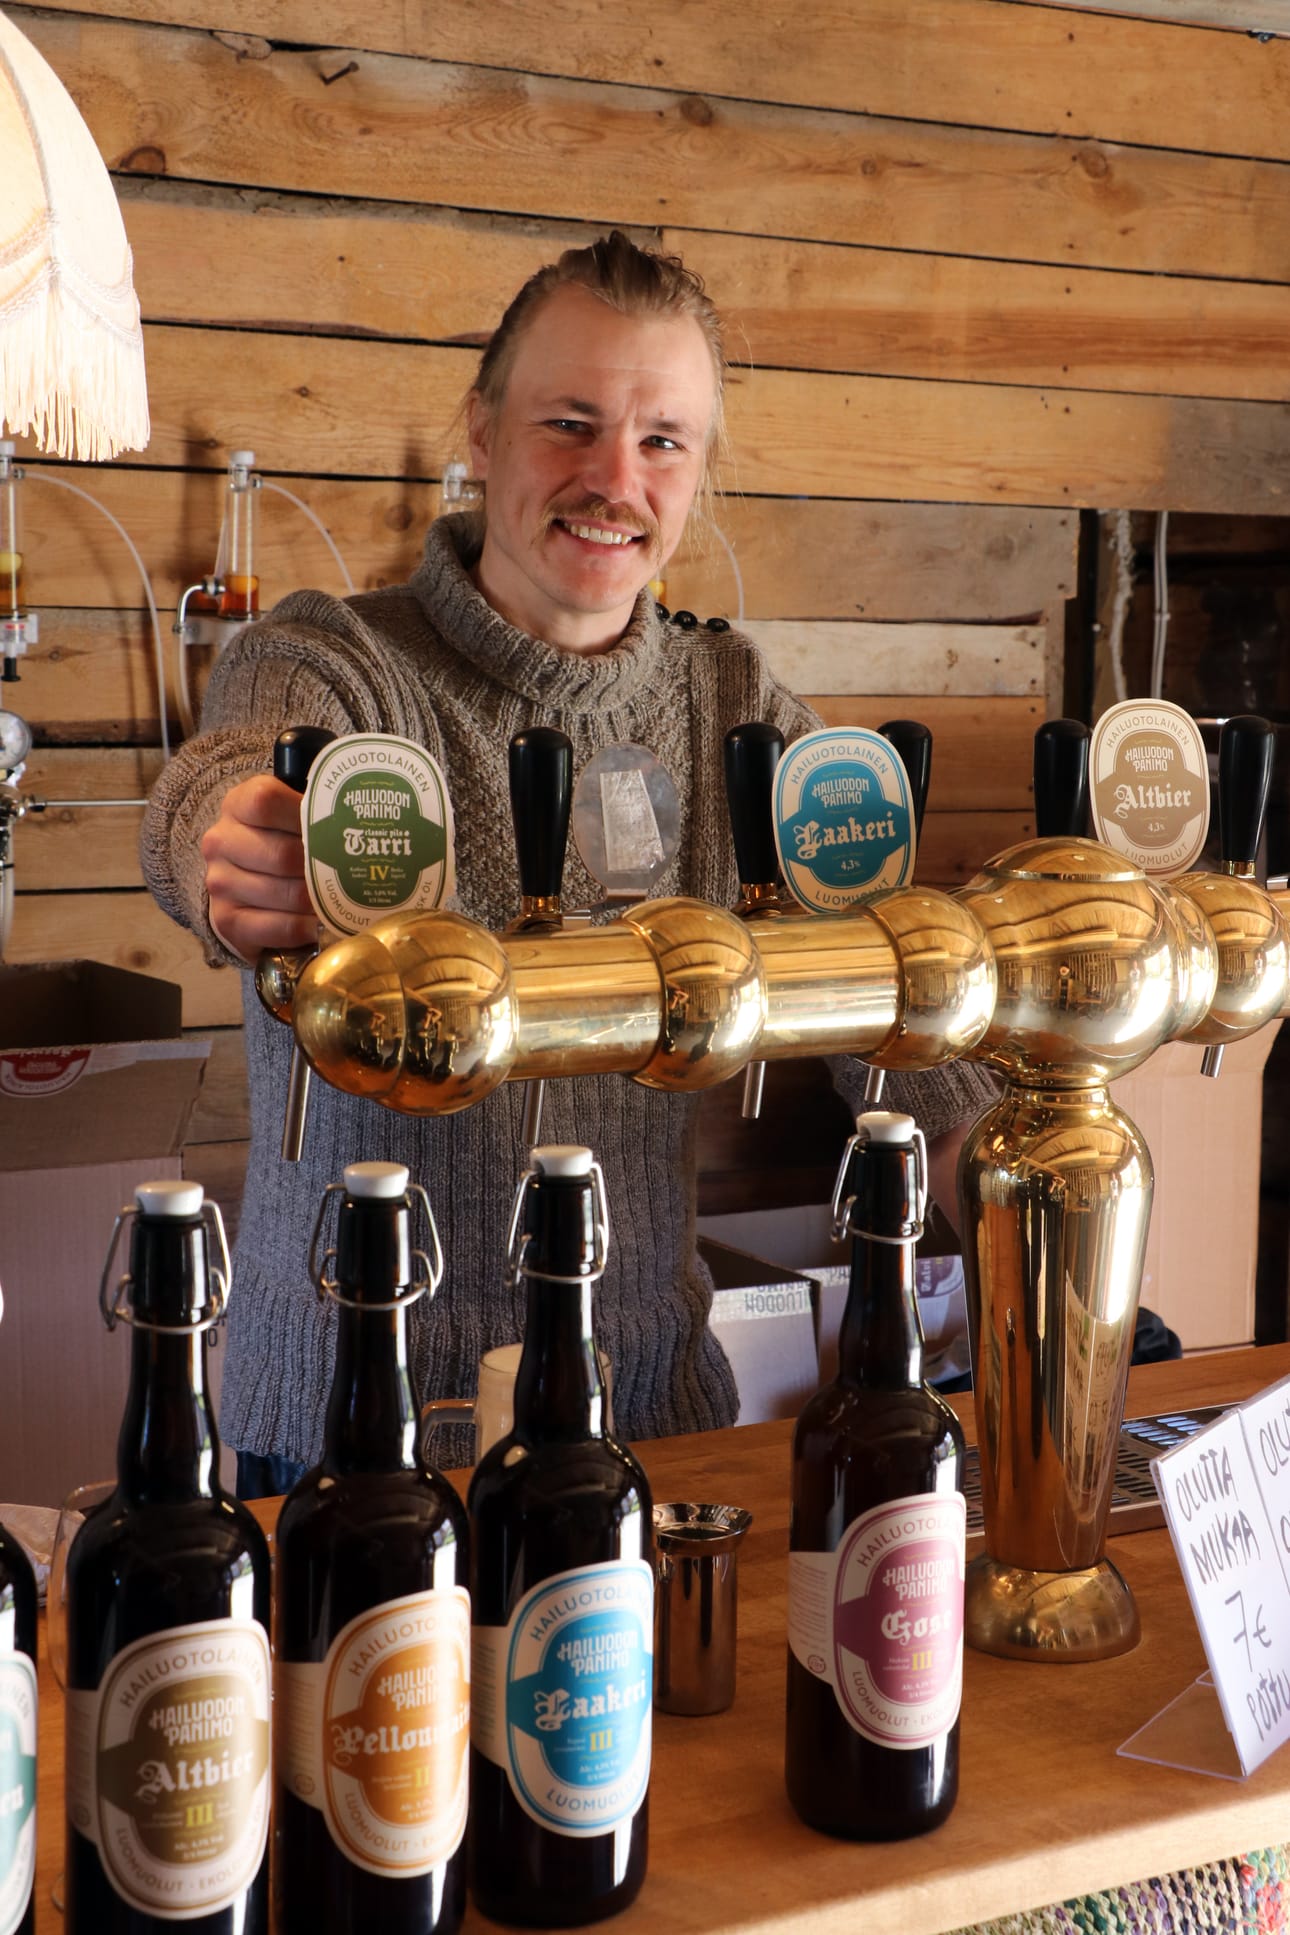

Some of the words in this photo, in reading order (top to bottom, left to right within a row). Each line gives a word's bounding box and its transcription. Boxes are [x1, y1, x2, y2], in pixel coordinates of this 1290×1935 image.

[1106, 715, 1190, 748] HAILUOTOLAINEN
[791, 745, 889, 785] HAILUOTOLAINEN
[1125, 746, 1174, 763] HAILUODON
[1132, 758, 1168, 773] PANIMO
[324, 752, 430, 793] HAILUOTOLAINEN
[343, 788, 410, 808] HAILUODON
[811, 777, 870, 798] HAILUODON
[820, 791, 862, 808] PANIMO
[1113, 783, 1192, 819] Altbier
[353, 804, 401, 820] PANIMO
[343, 827, 412, 856] Tarri
[369, 865, 390, 881] IV
[325, 878, 371, 926] LUOMUOLUT
[1176, 1445, 1239, 1522] OLUTTA
[570, 1652, 630, 1677] PANIMO
[852, 1671, 910, 1727] LUOMUOLUT
[164, 1718, 233, 1747] PANIMO
[590, 1728, 613, 1753] III
[186, 1801, 214, 1829] III
[344, 1791, 410, 1853] LUOMUOLUT
[116, 1827, 184, 1893] LUOMUOLUT
